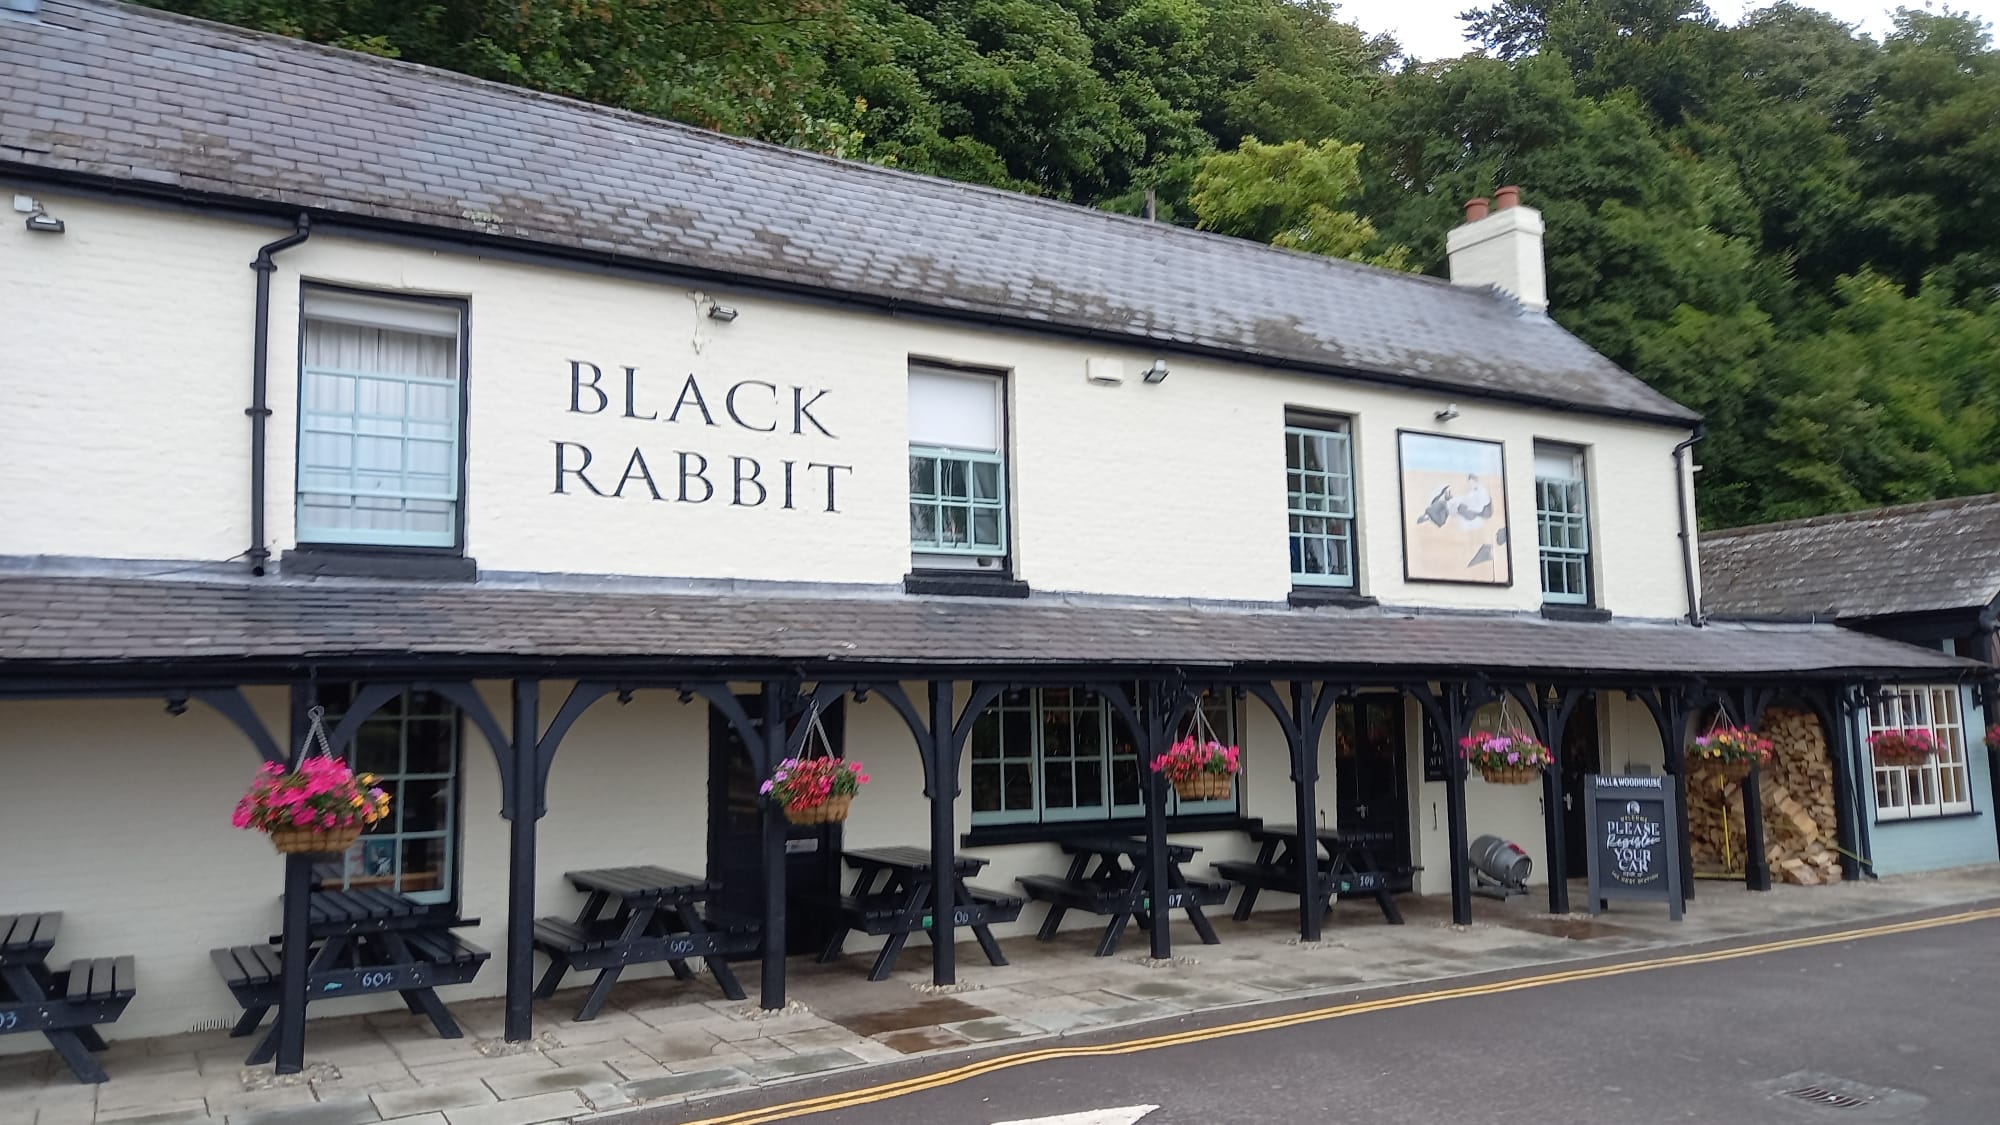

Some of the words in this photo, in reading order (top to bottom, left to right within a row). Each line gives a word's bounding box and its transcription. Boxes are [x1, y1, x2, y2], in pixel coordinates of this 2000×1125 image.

[566, 358, 840, 440] BLACK
[549, 440, 853, 514] RABBIT
[1607, 821, 1660, 836] PLEASE
[1614, 848, 1651, 862] YOUR
[1618, 859, 1648, 872] CAR
[1168, 893, 1183, 908] 07
